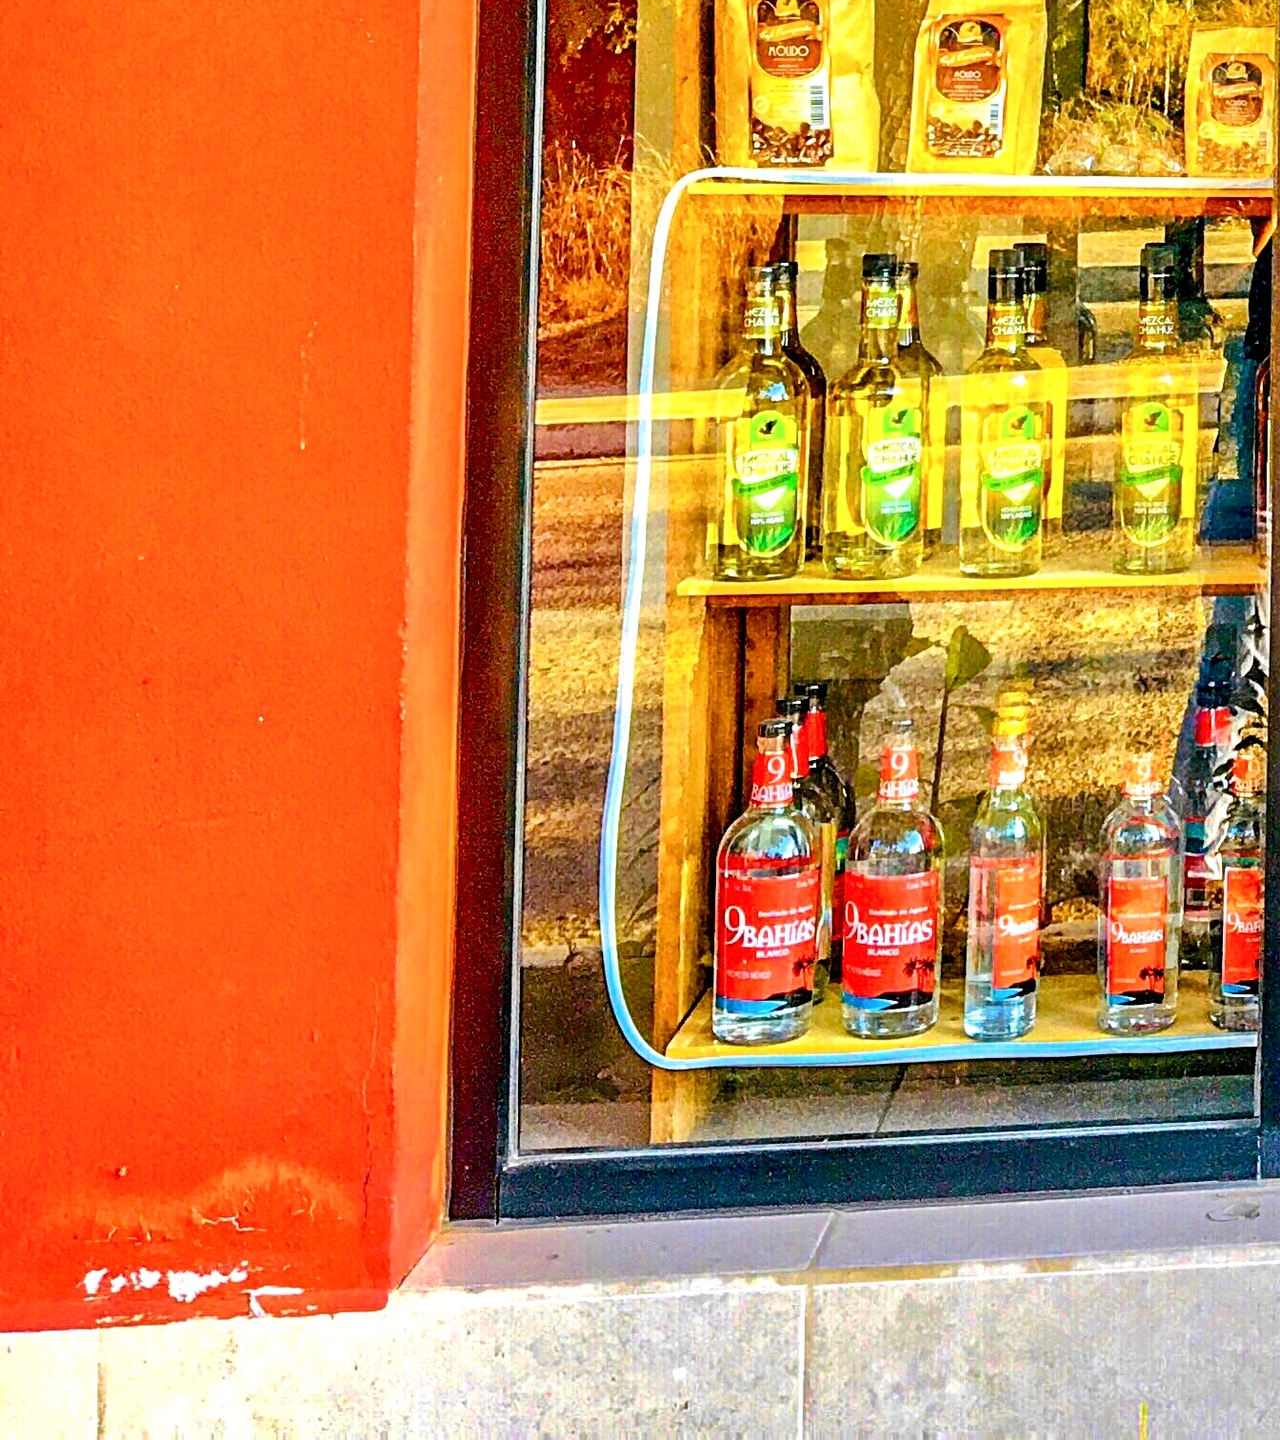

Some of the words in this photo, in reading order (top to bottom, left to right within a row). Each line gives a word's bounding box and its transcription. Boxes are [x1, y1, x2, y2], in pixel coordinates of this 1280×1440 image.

[767, 45, 810, 57] MOLIDO
[767, 755, 785, 784] 9
[891, 752, 909, 779] 9
[1137, 760, 1151, 781] 9
[755, 948, 790, 959] BLANCO
[867, 947, 900, 957] BLANCO
